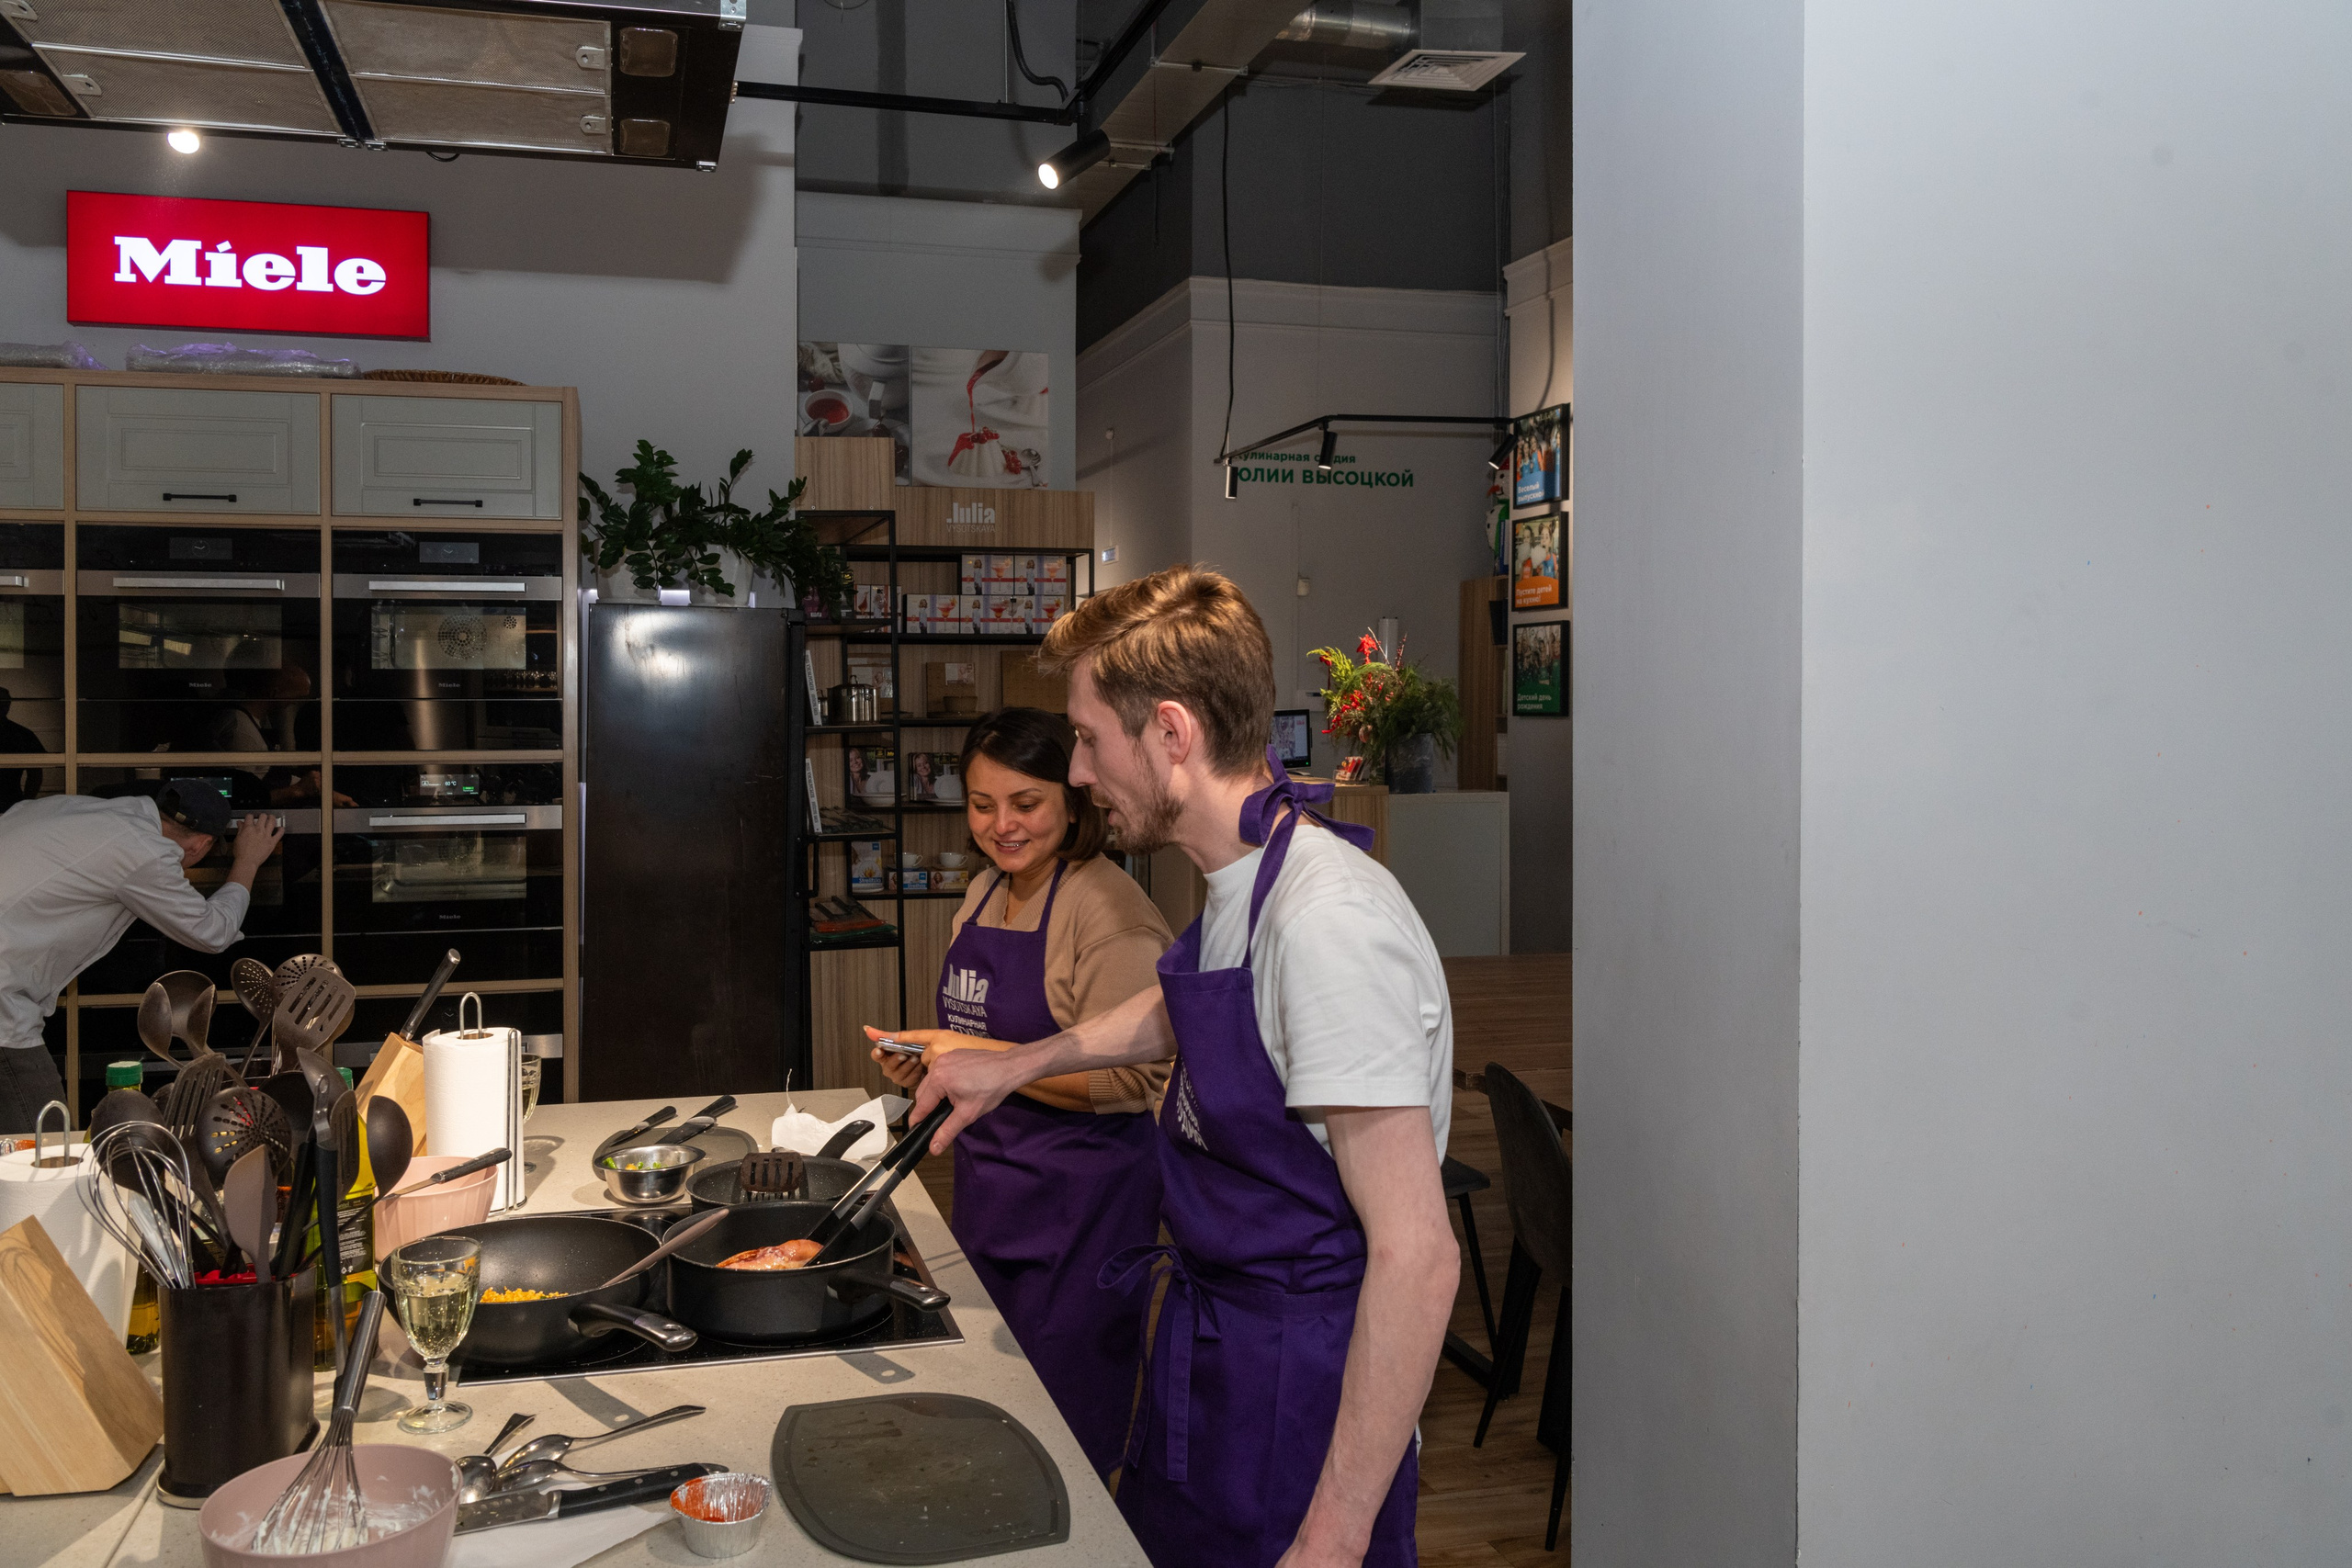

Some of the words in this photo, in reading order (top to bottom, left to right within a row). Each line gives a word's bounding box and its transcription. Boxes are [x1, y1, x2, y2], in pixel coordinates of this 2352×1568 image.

[114, 235, 387, 295] Miele
[1314, 454, 1356, 464] сдия
[1302, 469, 1414, 488] ВЫСОЦКОЙ
[946, 502, 996, 524] Julia
[946, 525, 996, 533] VYSOTSKAYA
[1517, 693, 1538, 701] Детский
[943, 963, 989, 1004] Julia
[942, 996, 988, 1018] VYSOTSKAYA
[947, 1013, 988, 1031] КУЛИНАРНАЯ
